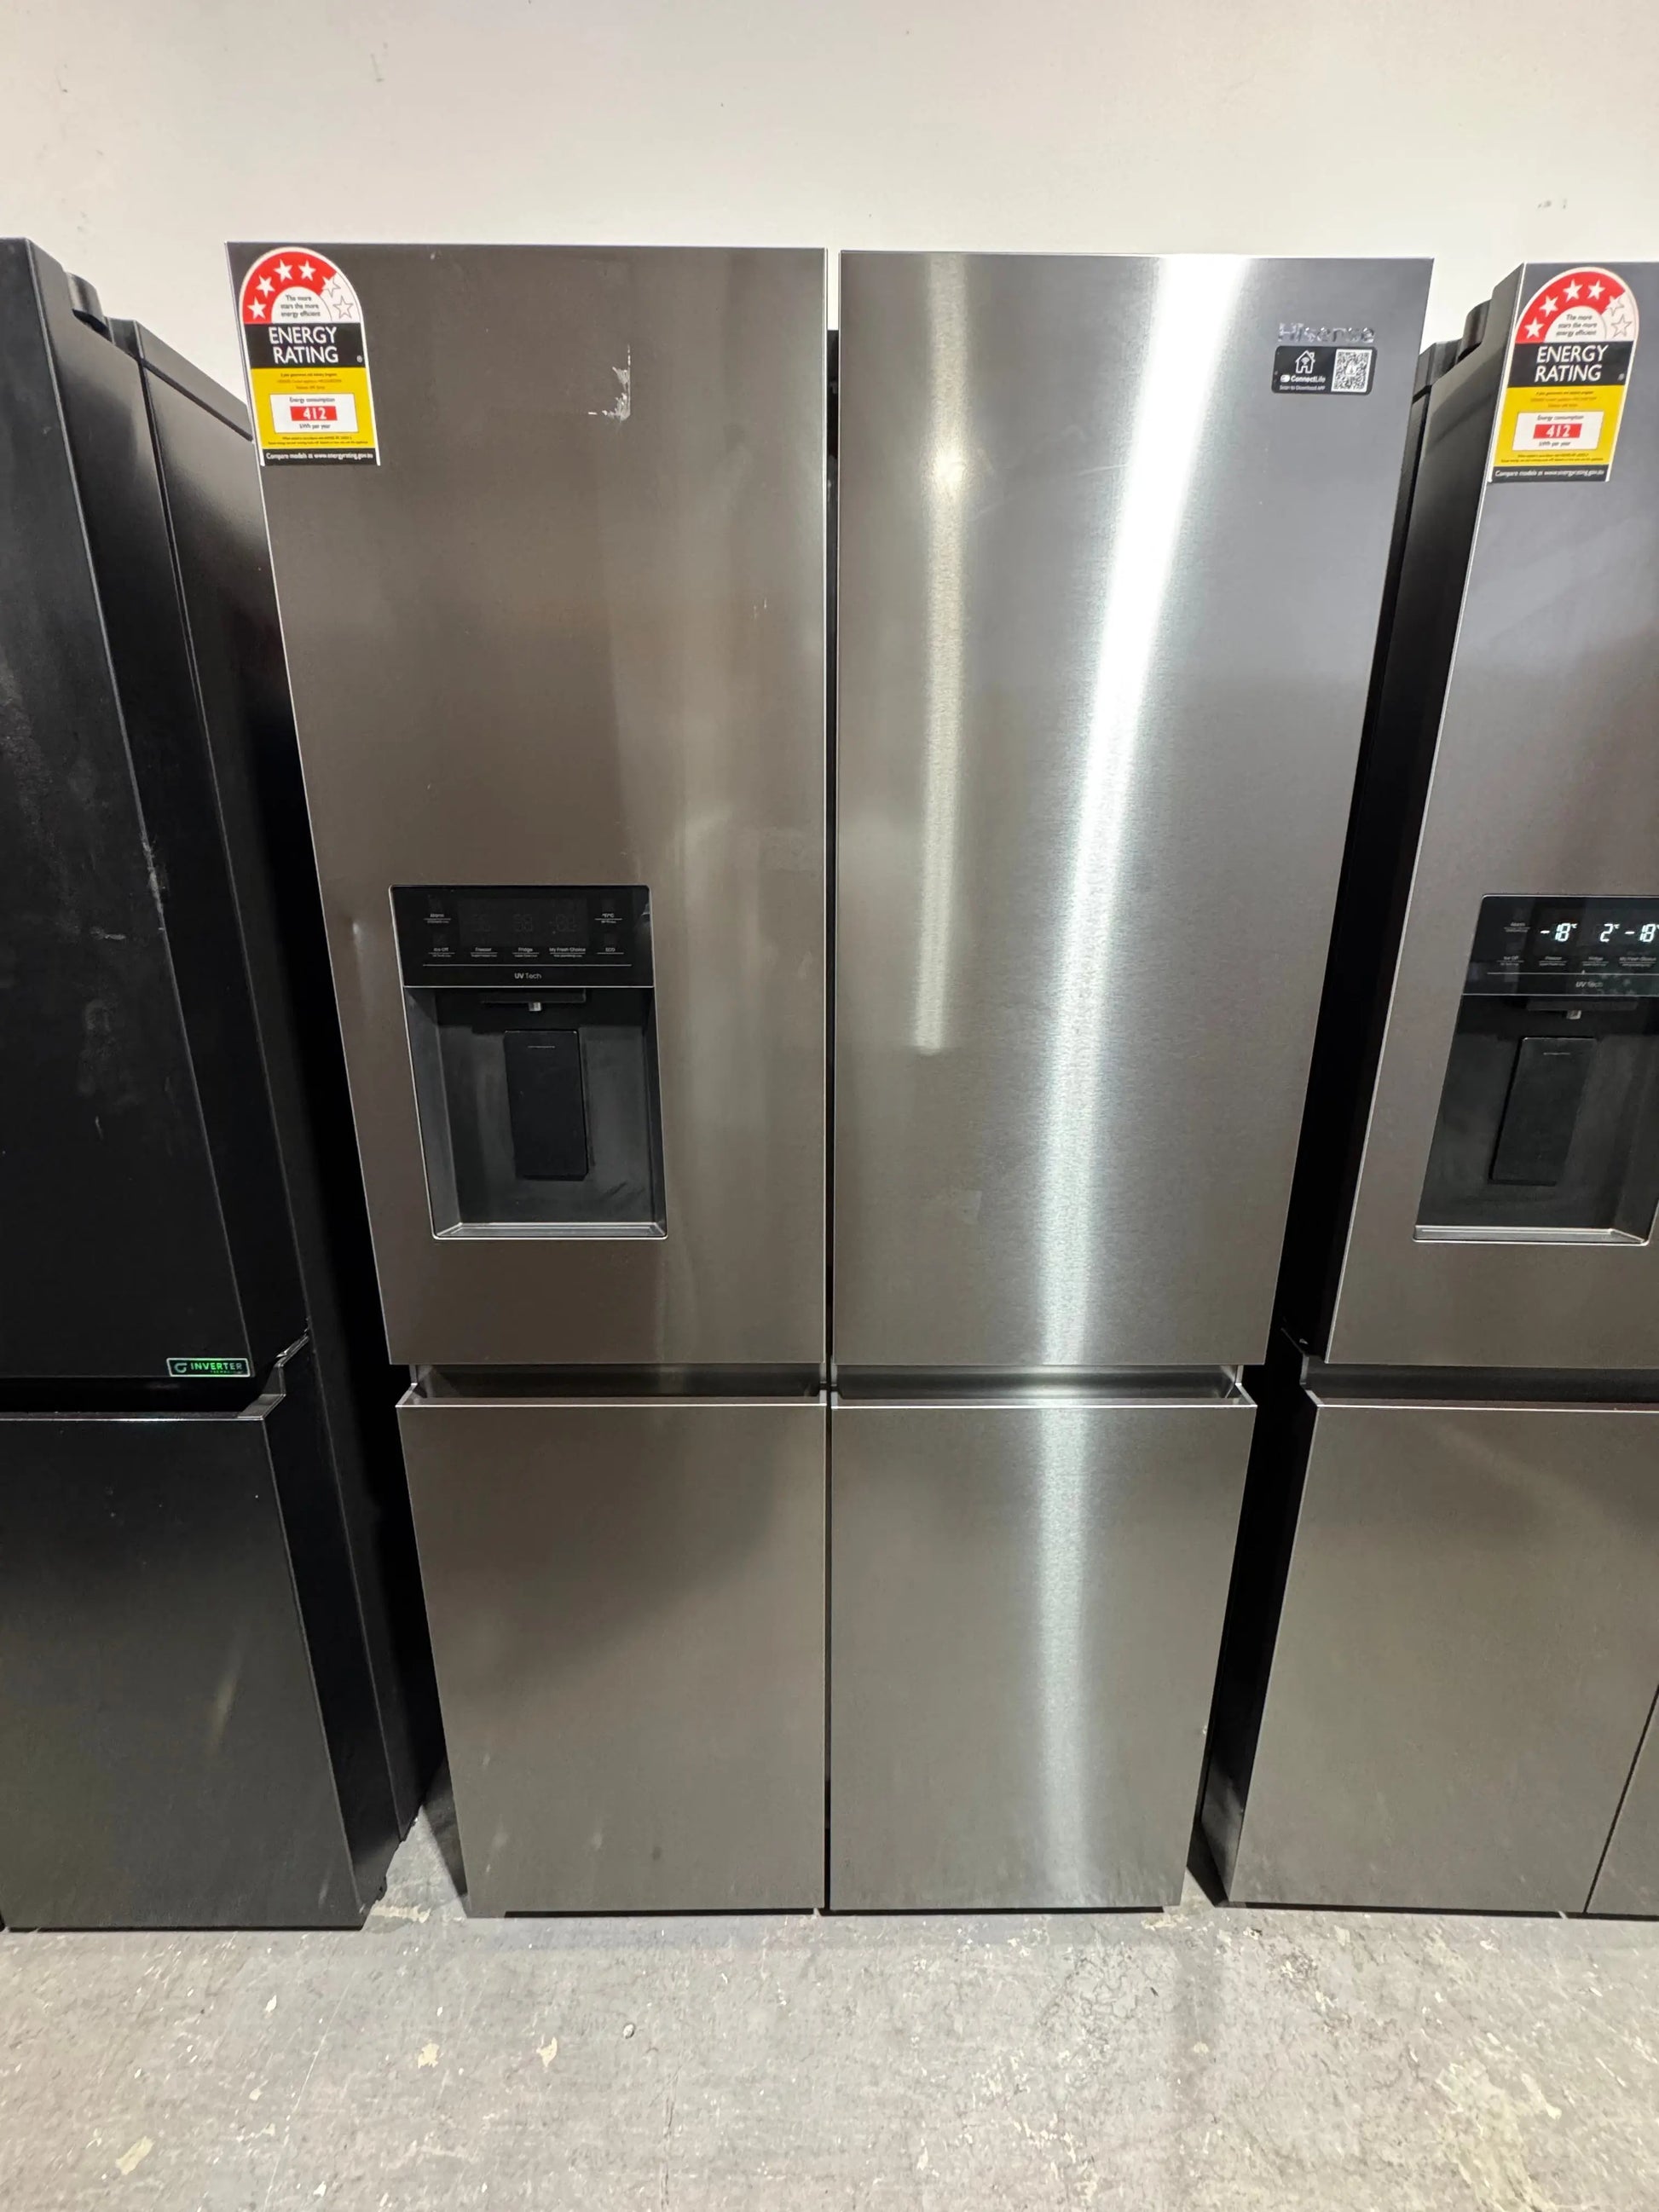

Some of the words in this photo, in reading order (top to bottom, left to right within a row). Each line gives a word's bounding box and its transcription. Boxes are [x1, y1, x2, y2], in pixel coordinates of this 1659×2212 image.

[268, 326, 337, 345] ENERGY
[1277, 322, 1375, 343] Hisense
[273, 346, 339, 364] RATING
[1537, 344, 1609, 363] ENERGY
[1291, 375, 1326, 383] ConnectLife
[1534, 364, 1602, 383] RATING
[303, 407, 327, 420] 412
[1546, 424, 1571, 438] 412
